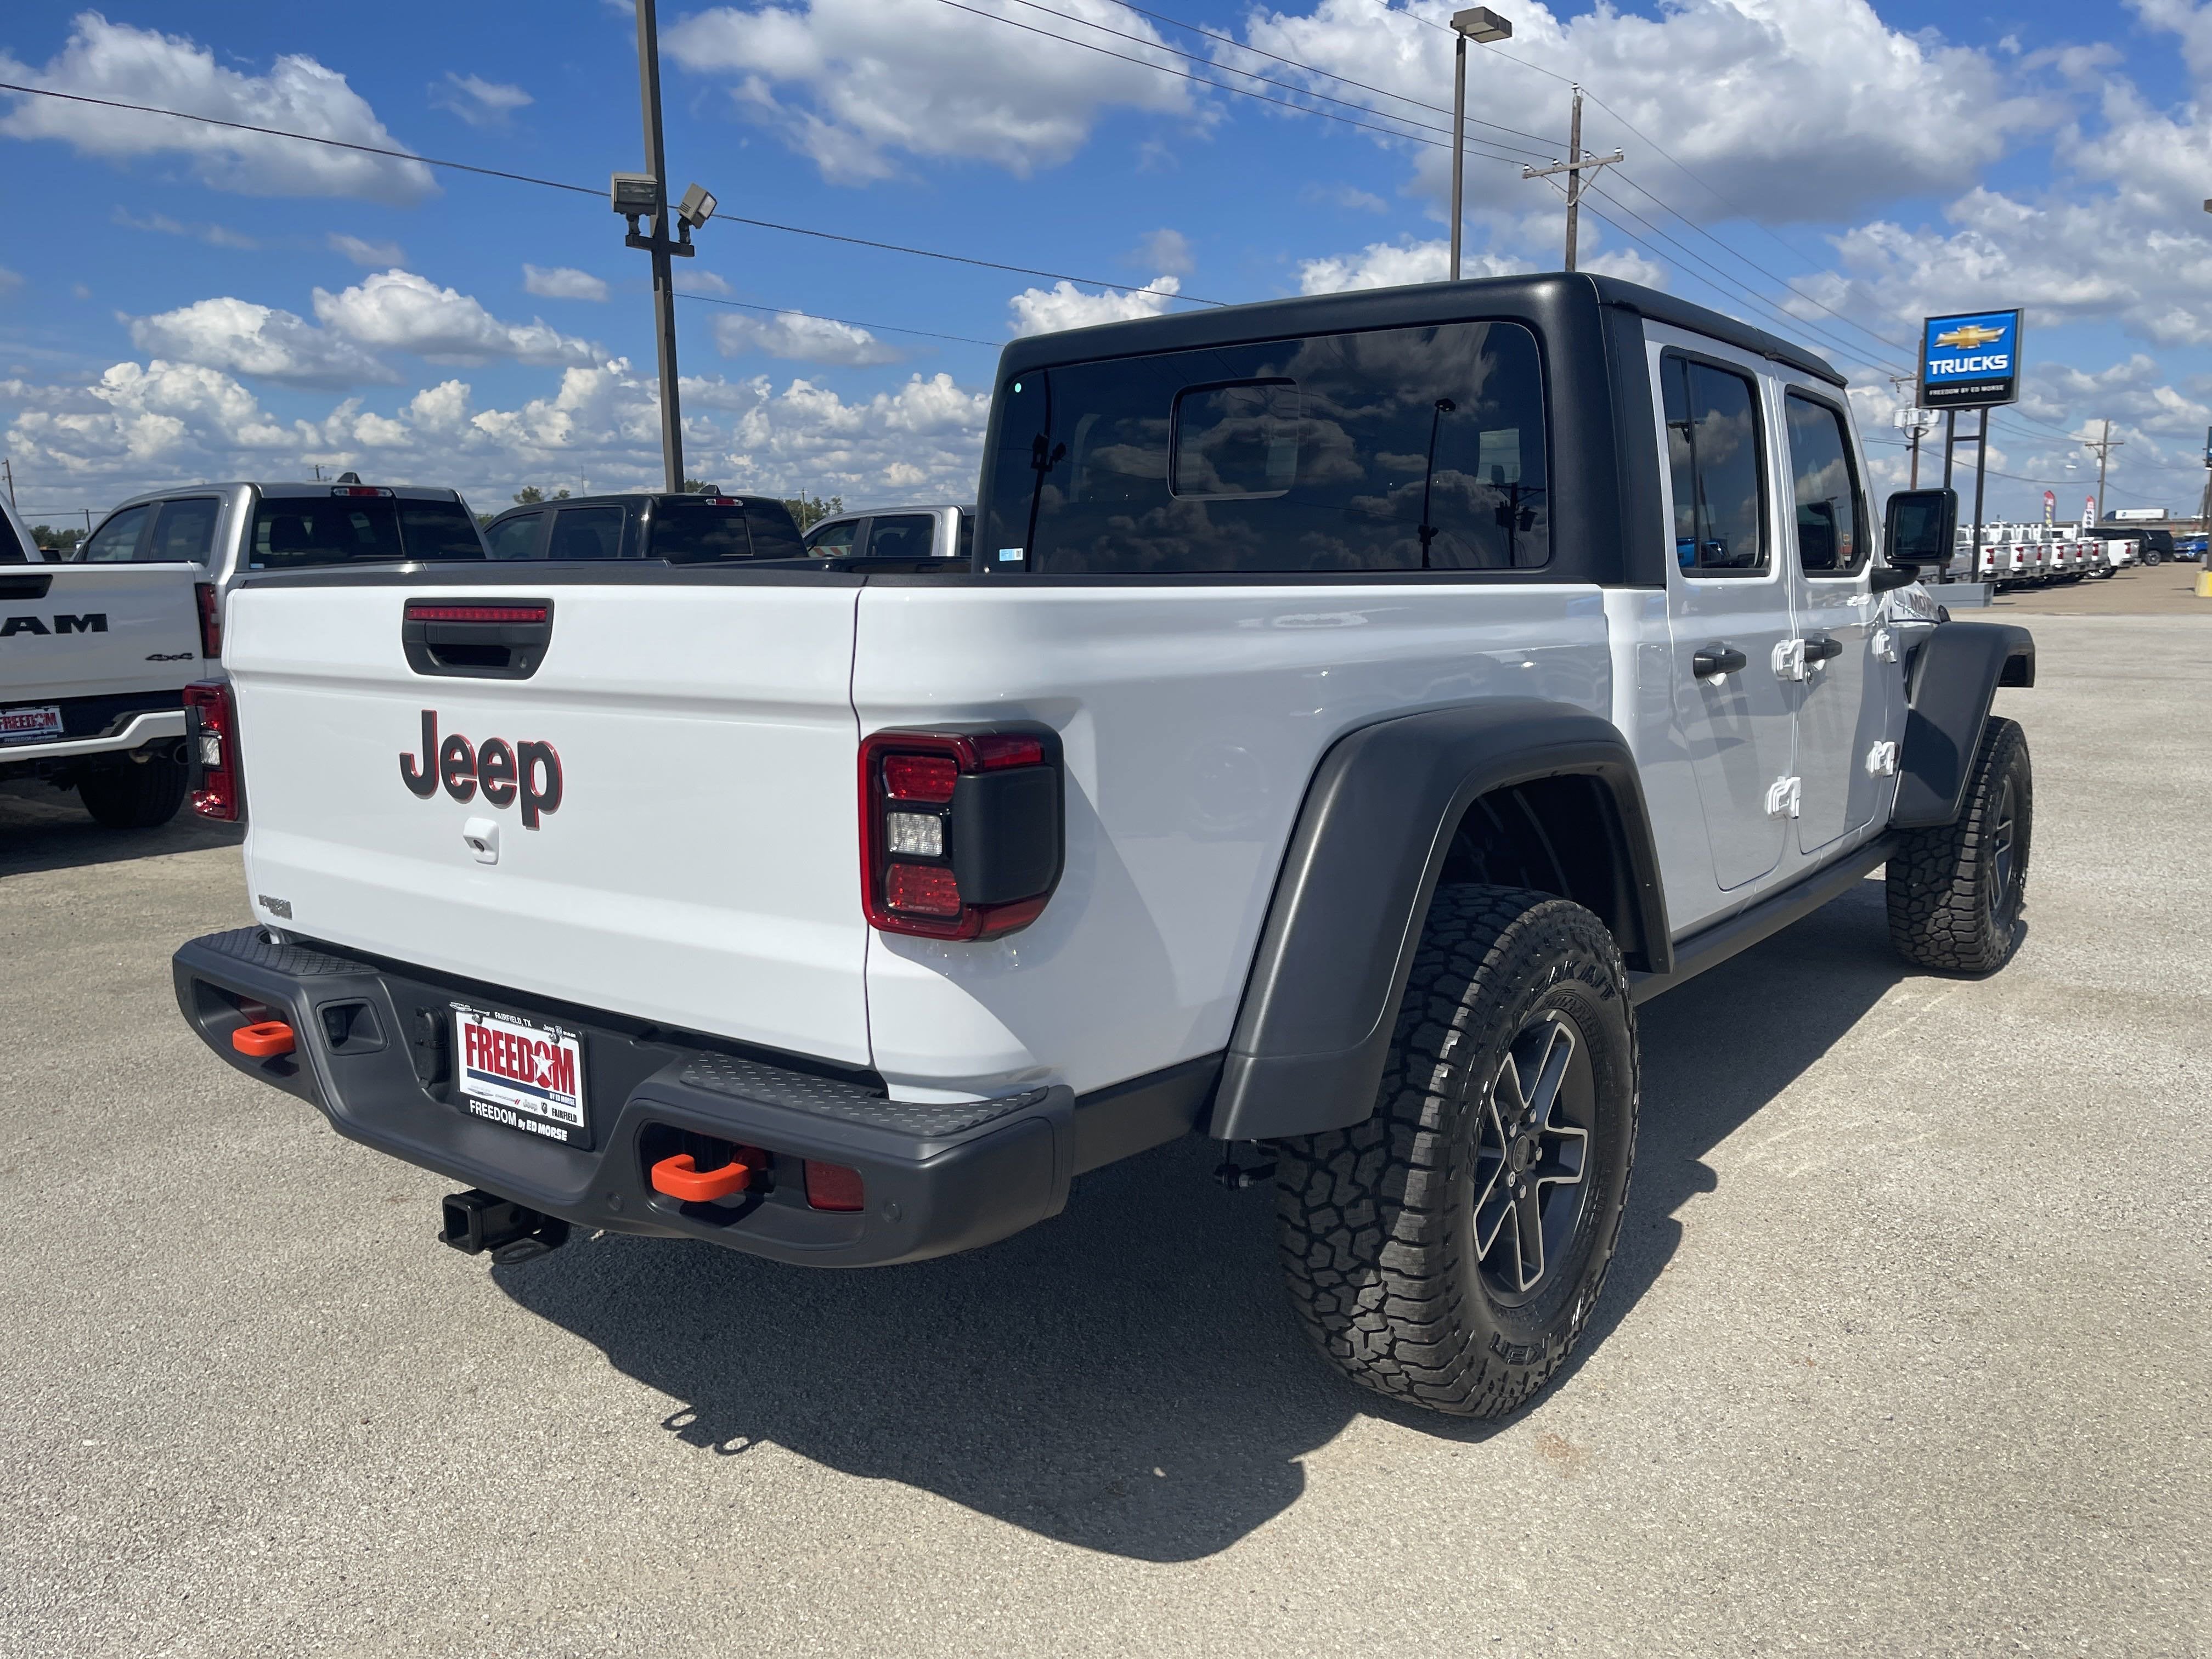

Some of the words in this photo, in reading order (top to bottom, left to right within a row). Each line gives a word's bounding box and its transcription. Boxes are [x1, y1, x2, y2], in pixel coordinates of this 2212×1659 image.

[1929, 354, 2008, 375] TRUCKS
[399, 709, 564, 831] Jeep
[494, 1012, 523, 1026] FAIRFIELD,
[523, 1018, 532, 1027] TX
[464, 1022, 575, 1096] FREEDOM
[561, 1096, 575, 1106] MORSE
[470, 1099, 517, 1126] FREEDOM
[526, 1120, 537, 1132] ED
[538, 1122, 567, 1142] MORSE
[552, 1108, 577, 1122] FAIRFIELD
